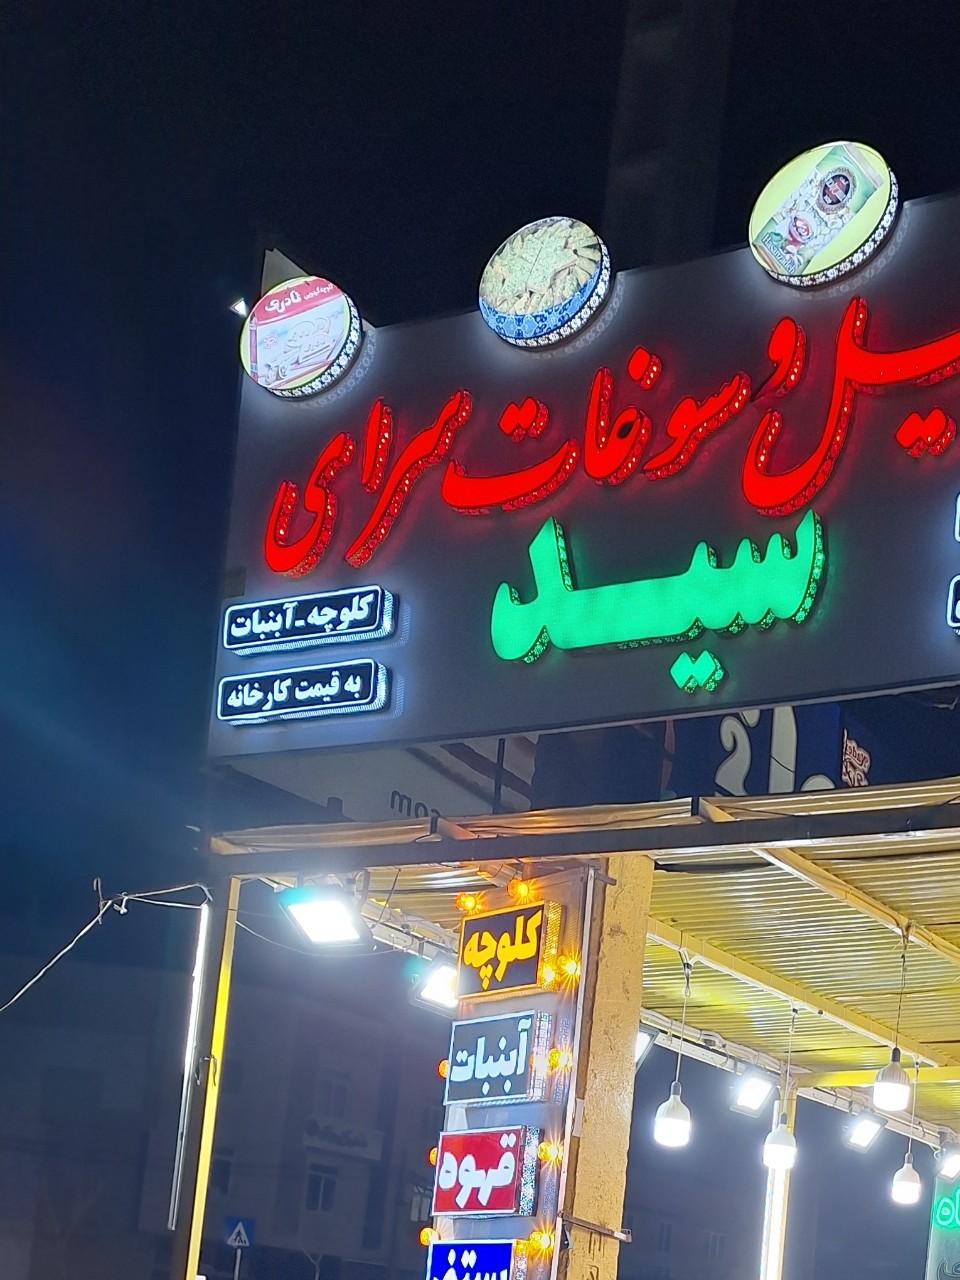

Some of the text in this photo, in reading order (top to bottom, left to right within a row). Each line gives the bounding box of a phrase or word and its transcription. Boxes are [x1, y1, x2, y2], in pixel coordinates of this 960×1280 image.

[753, 318, 805, 400] و
[440, 349, 752, 515] سوغات
[227, 670, 362, 711] به قیمت کارخانه
[463, 909, 542, 990] کلوچه
[450, 1018, 532, 1096] آبنبات
[439, 1133, 516, 1208] قهوه
